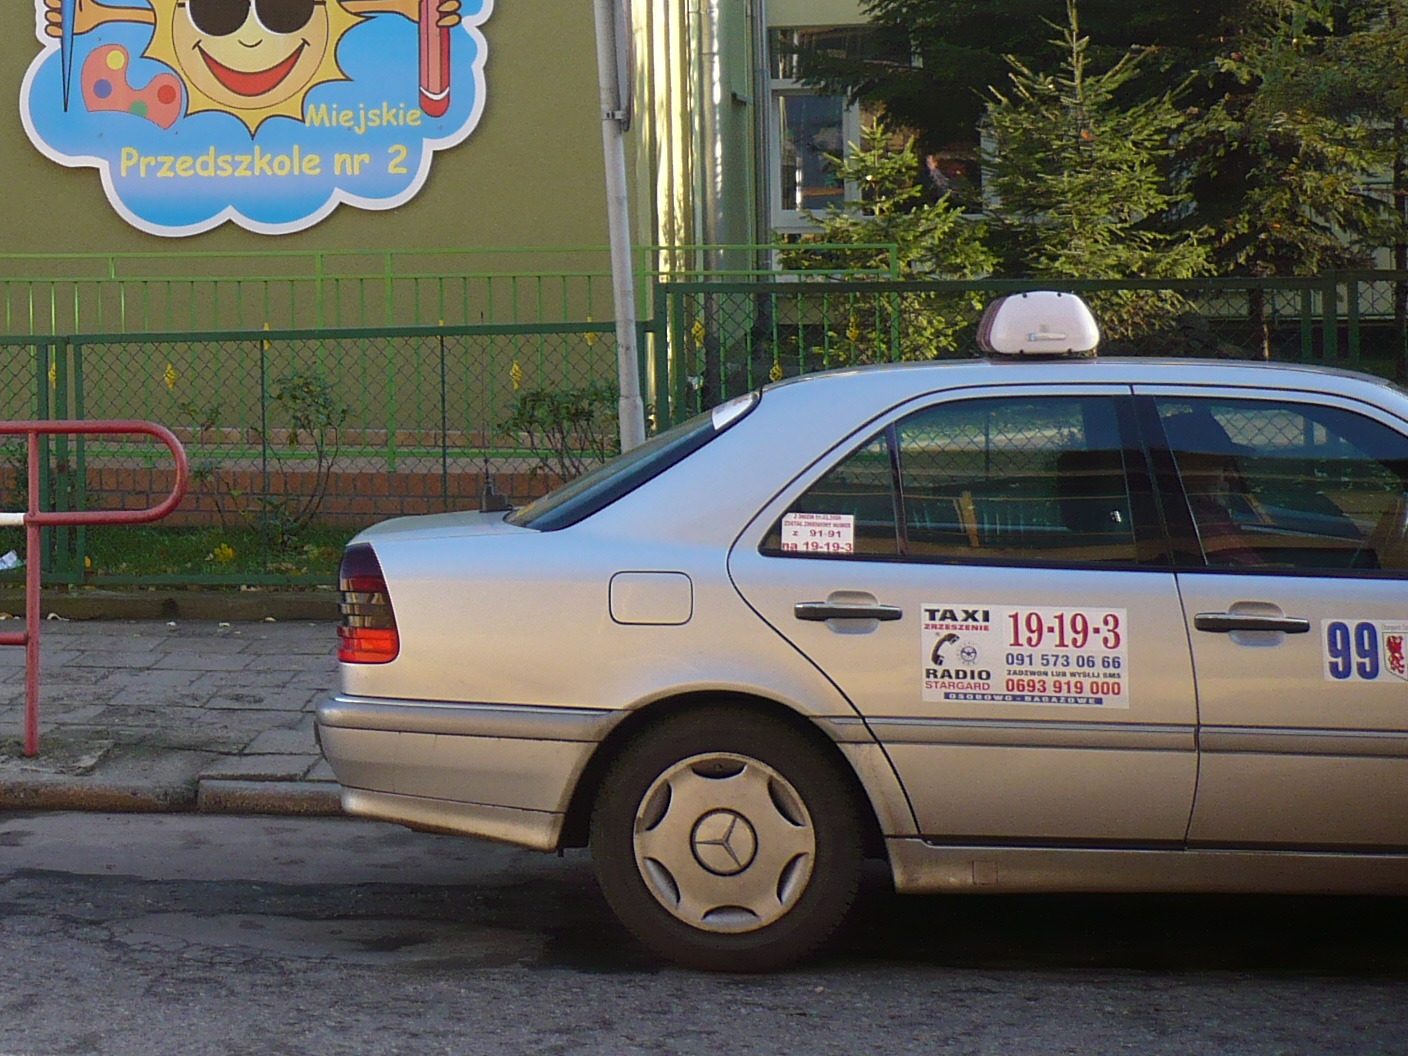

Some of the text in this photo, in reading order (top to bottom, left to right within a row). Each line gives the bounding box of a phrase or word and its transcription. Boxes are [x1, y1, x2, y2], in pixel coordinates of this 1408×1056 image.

[305, 102, 421, 134] Miejskie
[120, 144, 408, 178] Przedszkole nr 2
[782, 542, 852, 552] na 19-19-3
[924, 608, 990, 623] TAXI
[924, 623, 989, 631] ZRZESZENIE
[1327, 621, 1380, 680] 99
[1005, 653, 1121, 669] 091 573 06 66
[925, 668, 991, 681] RADIO
[925, 681, 990, 691] STARGARD
[1005, 678, 1121, 695] 0693 919 000
